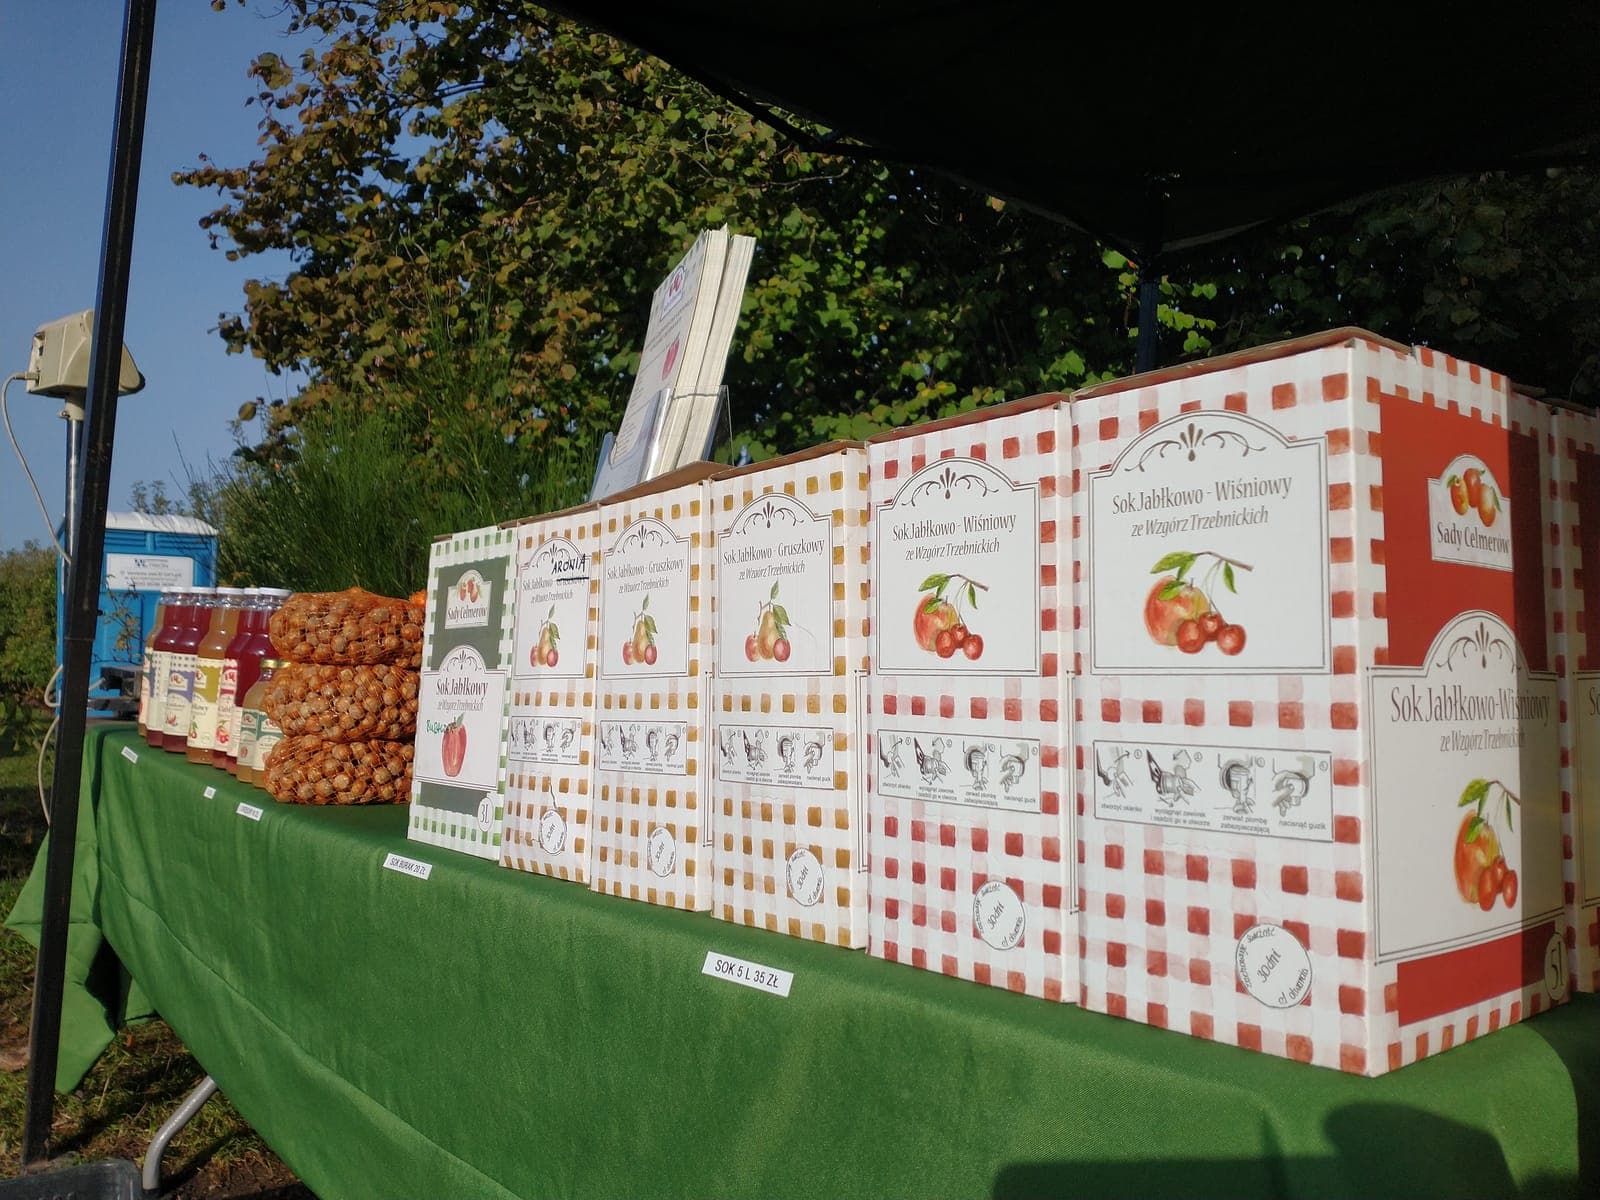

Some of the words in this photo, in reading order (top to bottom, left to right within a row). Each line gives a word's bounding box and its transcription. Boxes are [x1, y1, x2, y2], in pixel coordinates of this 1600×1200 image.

[1112, 491, 1138, 515] Sok
[1137, 486, 1203, 512] Jabłkowo
[1215, 476, 1292, 501] Wiśniowy
[892, 522, 910, 541] Sok
[908, 519, 956, 540] Jabłkowo
[963, 513, 1017, 533] Wiśniowy
[1131, 524, 1144, 537] ze
[1145, 518, 1189, 538] Wzgórz
[1190, 505, 1268, 531] Trzebnickich
[778, 538, 825, 556] Gruszkowy
[905, 550, 915, 561] ze
[915, 545, 945, 562] Wzgórz
[945, 537, 1000, 557] Trzebnickich
[1437, 521, 1462, 551] Sady
[551, 553, 586, 575] ARONIA
[436, 677, 449, 696] Sok
[450, 677, 488, 702] Jabłkowy
[1391, 684, 1424, 723] Sok
[1440, 734, 1450, 752] ze
[1451, 730, 1483, 756] Wzgórz
[714, 959, 736, 977] SOK
[736, 965, 744, 978] 5
[745, 967, 751, 981] L
[753, 969, 766, 984] 35
[766, 973, 779, 989] ZŁ
